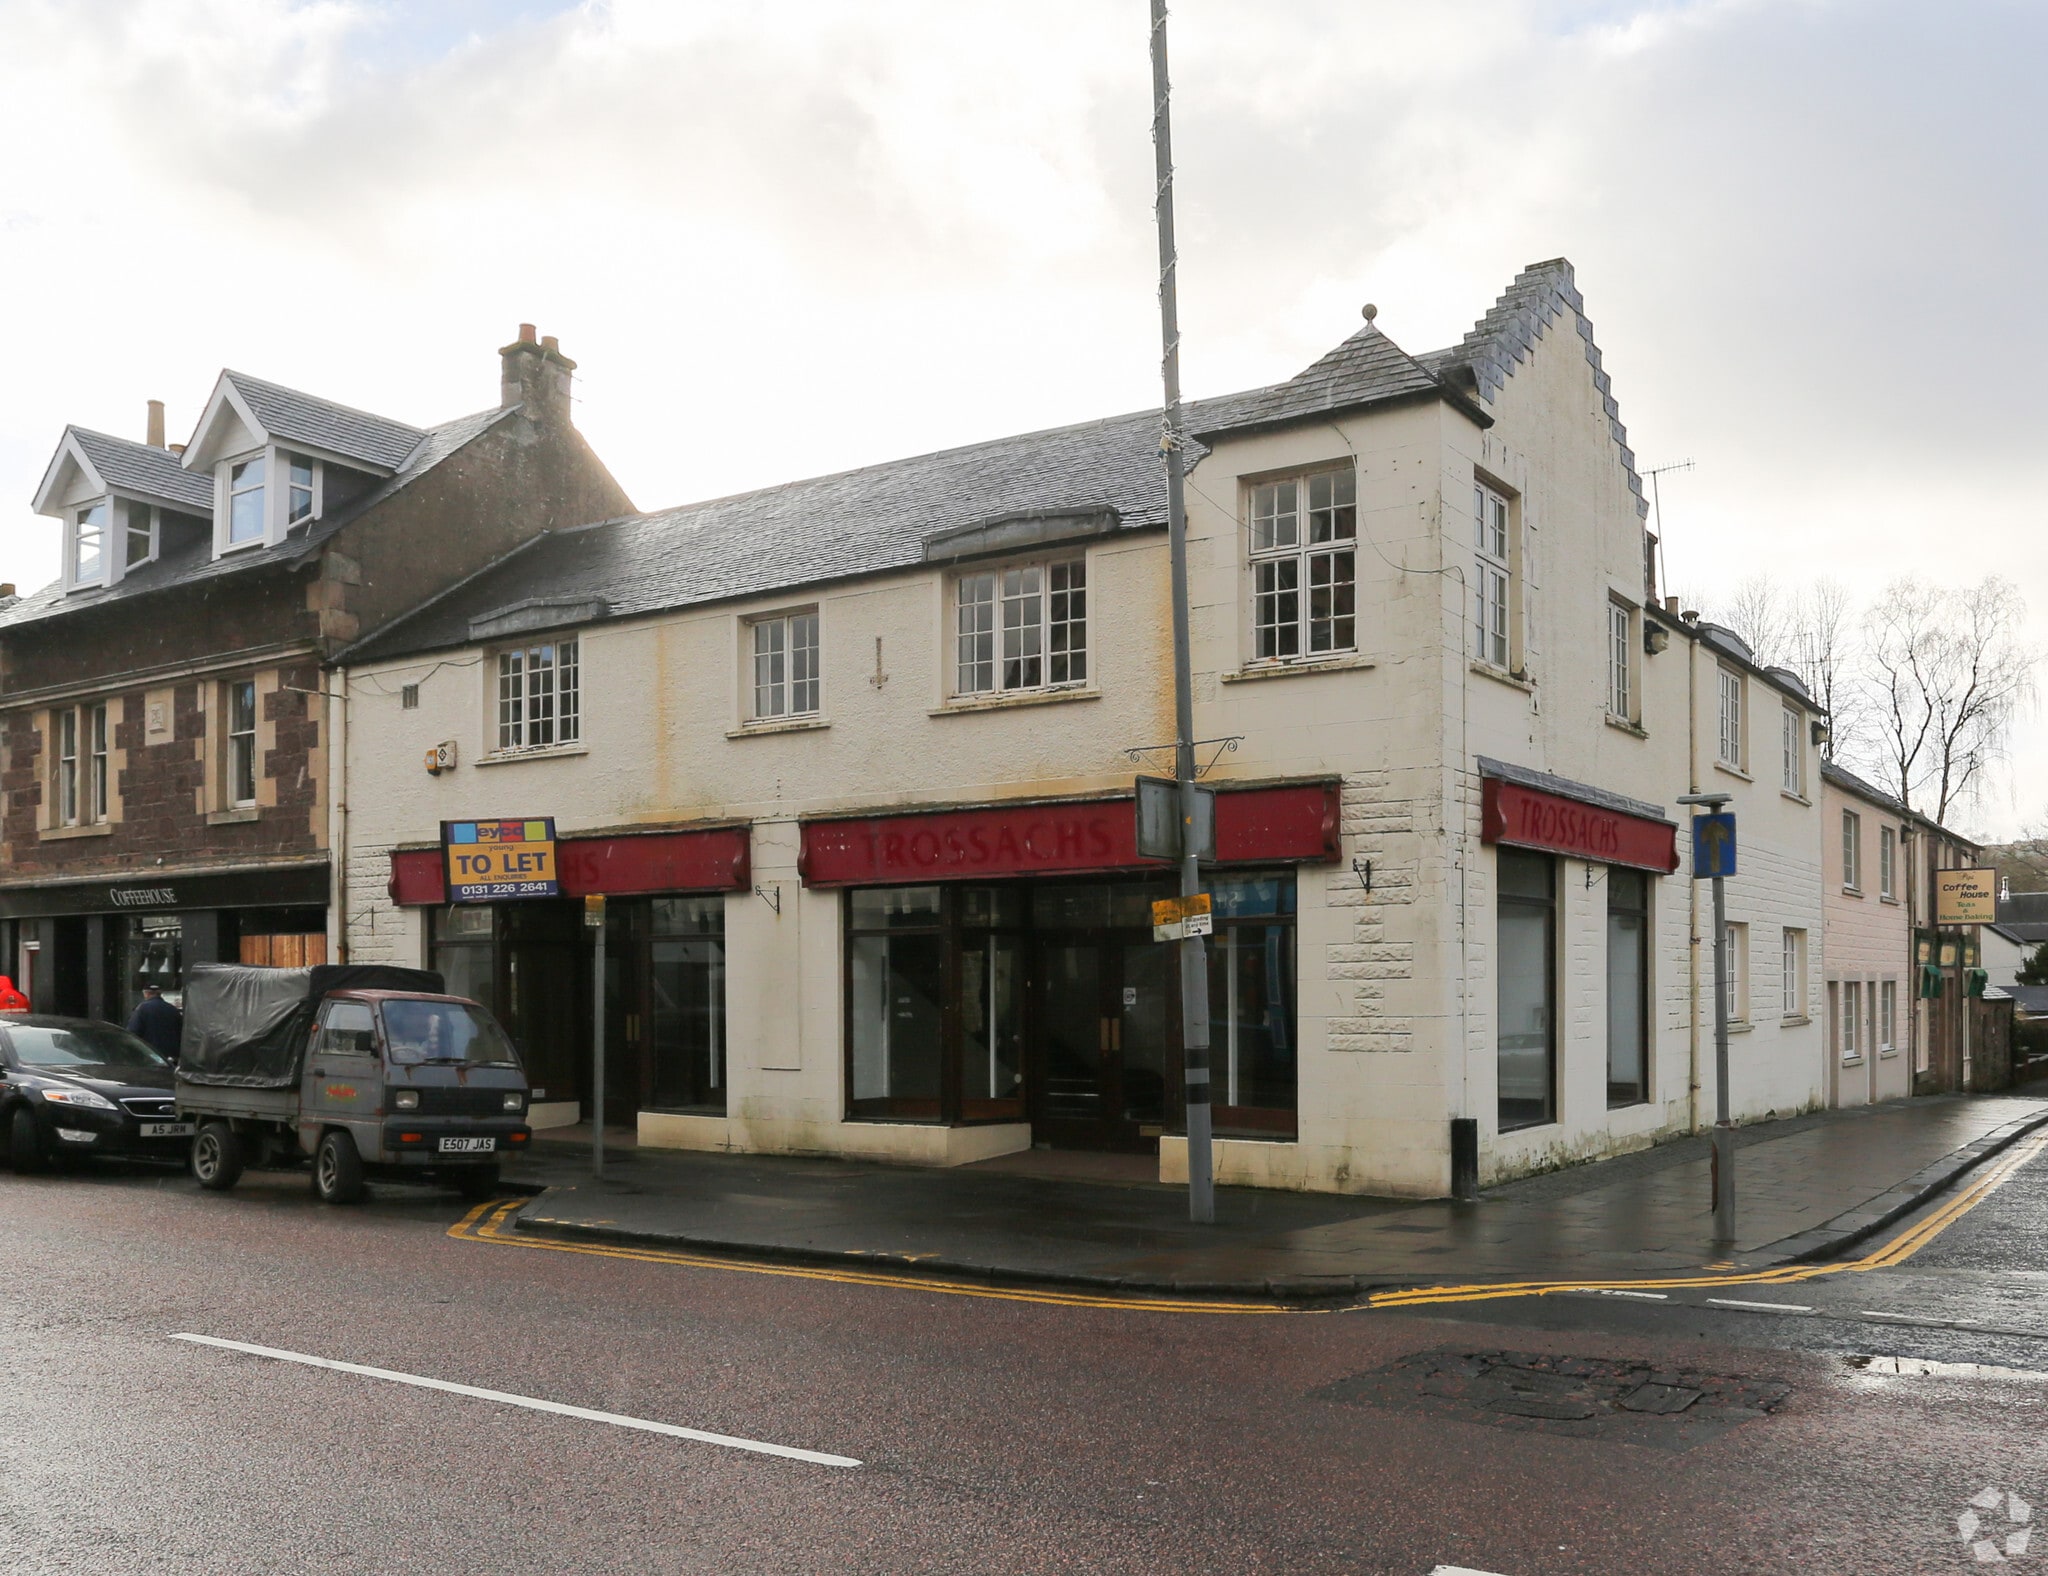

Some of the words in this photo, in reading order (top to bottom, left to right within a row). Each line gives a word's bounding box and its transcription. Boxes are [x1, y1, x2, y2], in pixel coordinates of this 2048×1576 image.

[1520, 798, 1619, 853] TROSSACHS
[860, 818, 1113, 868] TROSSACHS
[456, 854, 491, 875] TO
[503, 851, 547, 873] LET
[462, 885, 488, 895] 0131
[493, 883, 516, 893] 226
[520, 881, 548, 892] 2641
[1943, 884, 1978, 892] Coffee
[1964, 913, 1994, 921] Baking
[443, 1138, 470, 1150] E507
[472, 1138, 492, 1150] JAS
